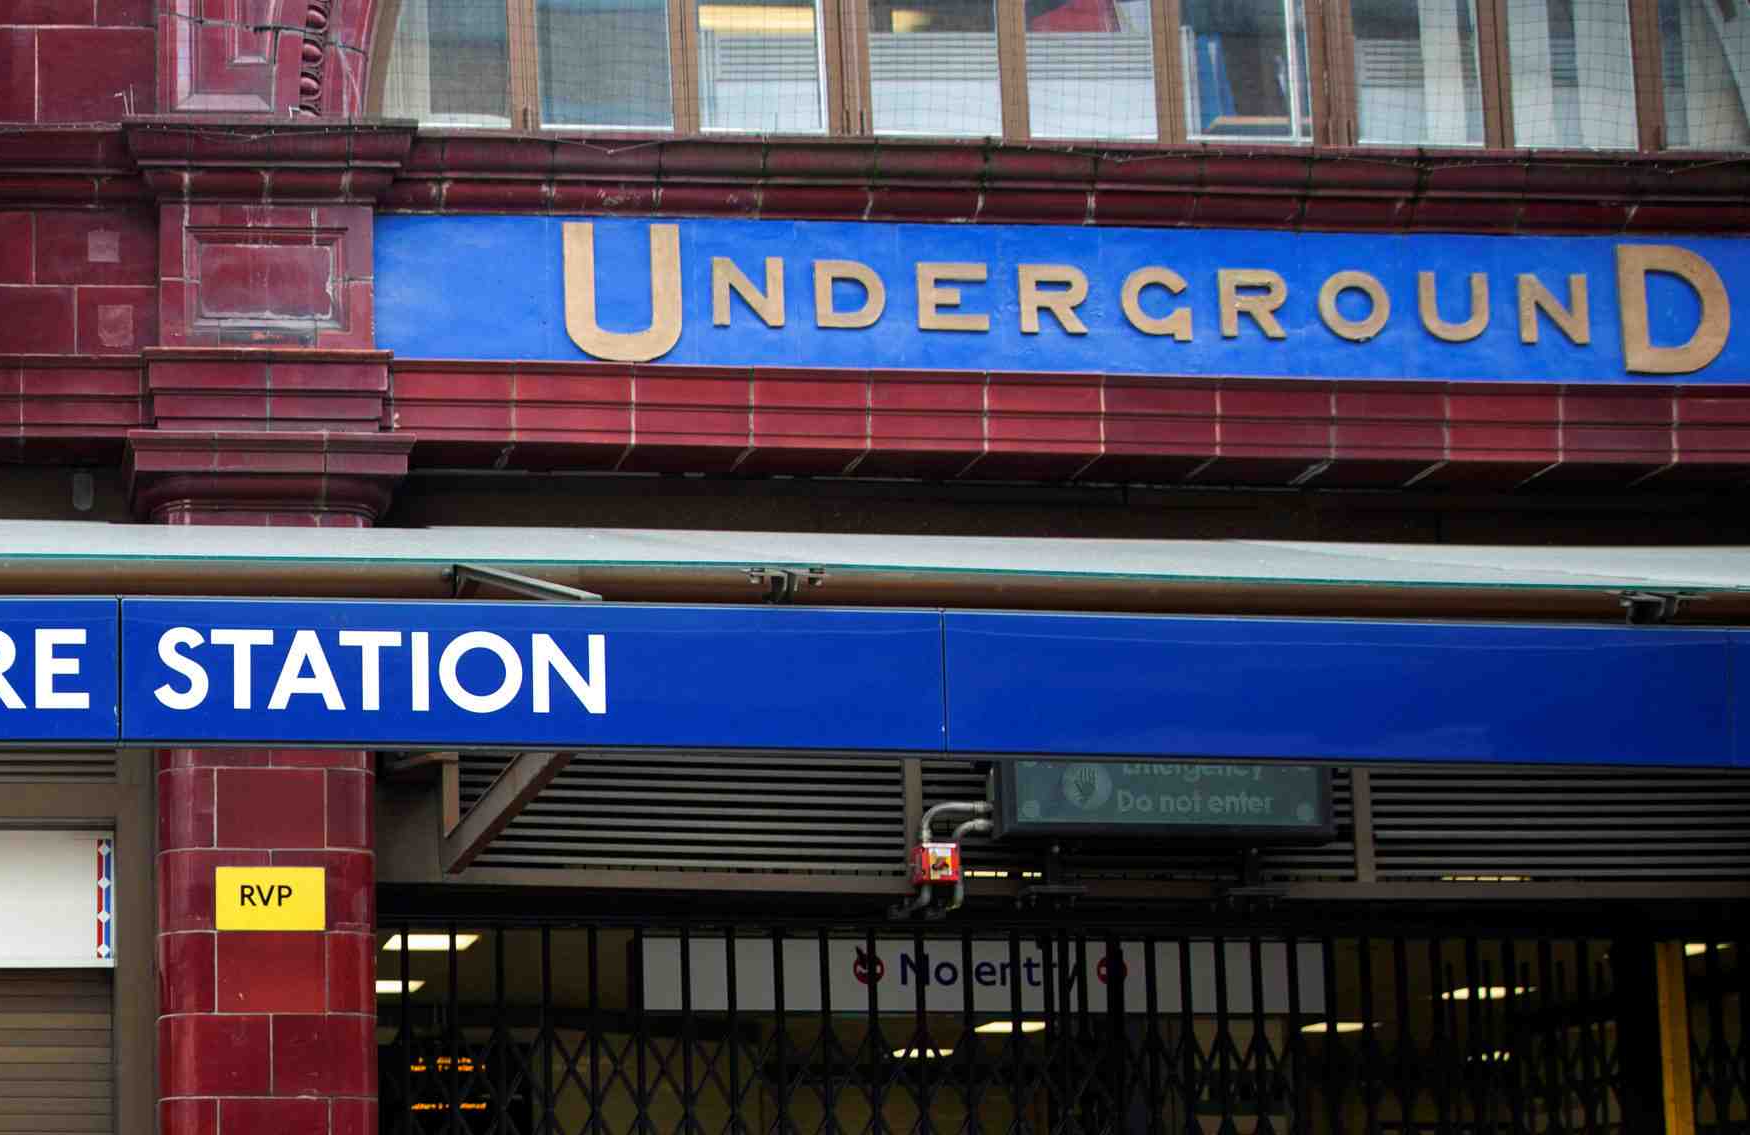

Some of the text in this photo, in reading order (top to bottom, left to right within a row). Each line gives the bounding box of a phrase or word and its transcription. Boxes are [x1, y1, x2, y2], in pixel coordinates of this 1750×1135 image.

[562, 221, 1731, 375] UNDERGROUND
[153, 626, 607, 714] STATION
[1116, 788, 1274, 815] Do not enter
[240, 884, 293, 907] RVP
[900, 953, 1084, 998] No enty
